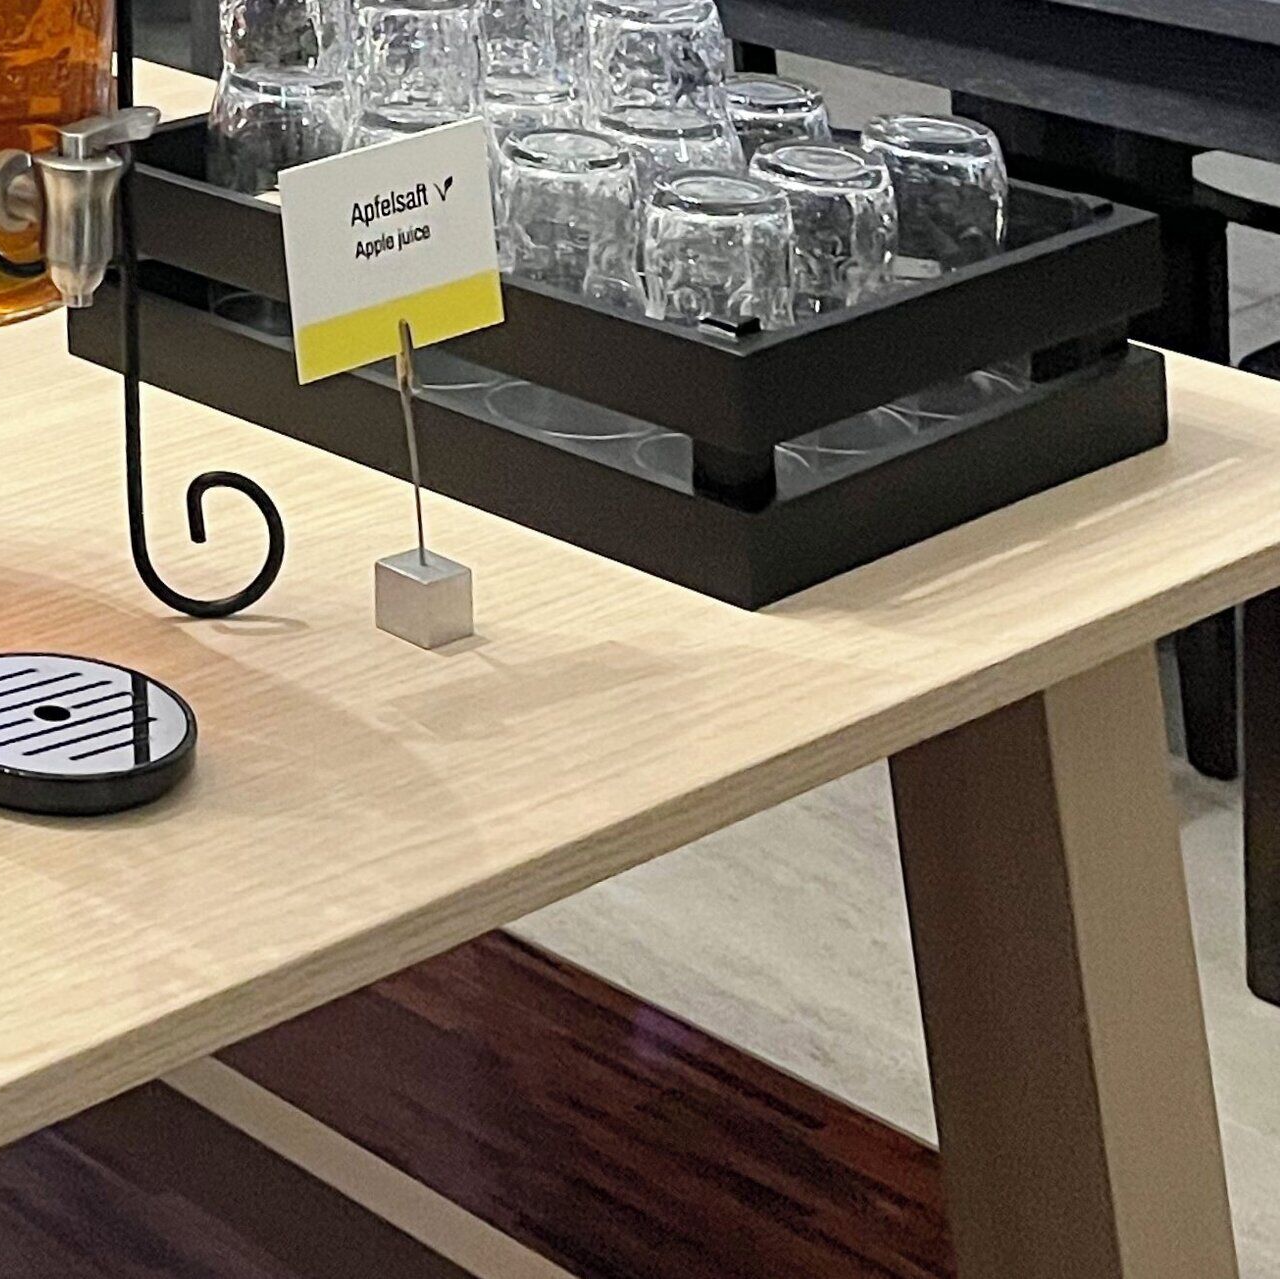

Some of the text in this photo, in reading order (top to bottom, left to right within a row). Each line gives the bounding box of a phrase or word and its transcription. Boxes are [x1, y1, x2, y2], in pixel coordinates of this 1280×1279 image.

[351, 183, 429, 227] Apfelsaft
[355, 224, 431, 259] Apple juice
